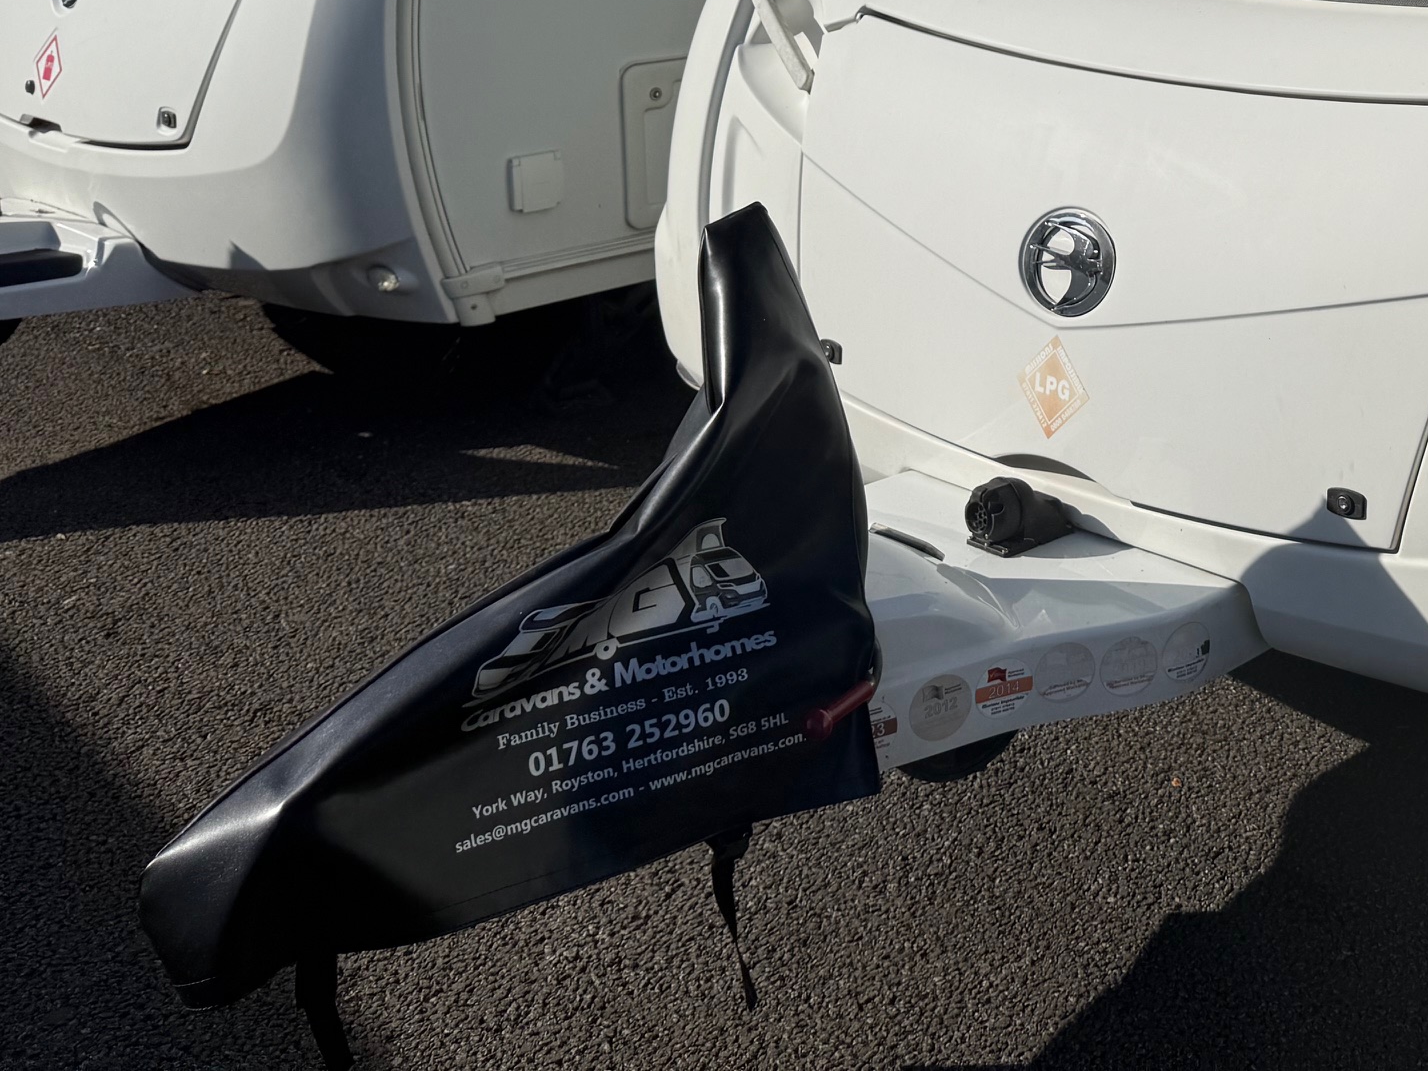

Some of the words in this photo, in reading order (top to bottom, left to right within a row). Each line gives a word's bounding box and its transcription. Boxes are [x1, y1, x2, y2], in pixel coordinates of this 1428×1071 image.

[1034, 371, 1071, 402] LPG
[461, 681, 581, 732] Caravans
[583, 667, 610, 696] &
[613, 630, 778, 689] Motorhomes
[496, 721, 561, 751] Family
[564, 697, 647, 730] Business
[661, 682, 700, 704] Est.
[705, 667, 750, 692] 1993
[923, 696, 959, 720] 2012
[988, 680, 1020, 700] 2014
[471, 797, 508, 820] York
[510, 787, 549, 808] Way,
[551, 765, 619, 795] Royston,
[621, 735, 726, 774] Hertfordshire,
[728, 721, 758, 741] SG8
[760, 712, 790, 731] 5HL
[528, 732, 617, 777] 01763
[625, 698, 731, 750] 252960
[454, 786, 635, 854] sales@mgcaravans.com
